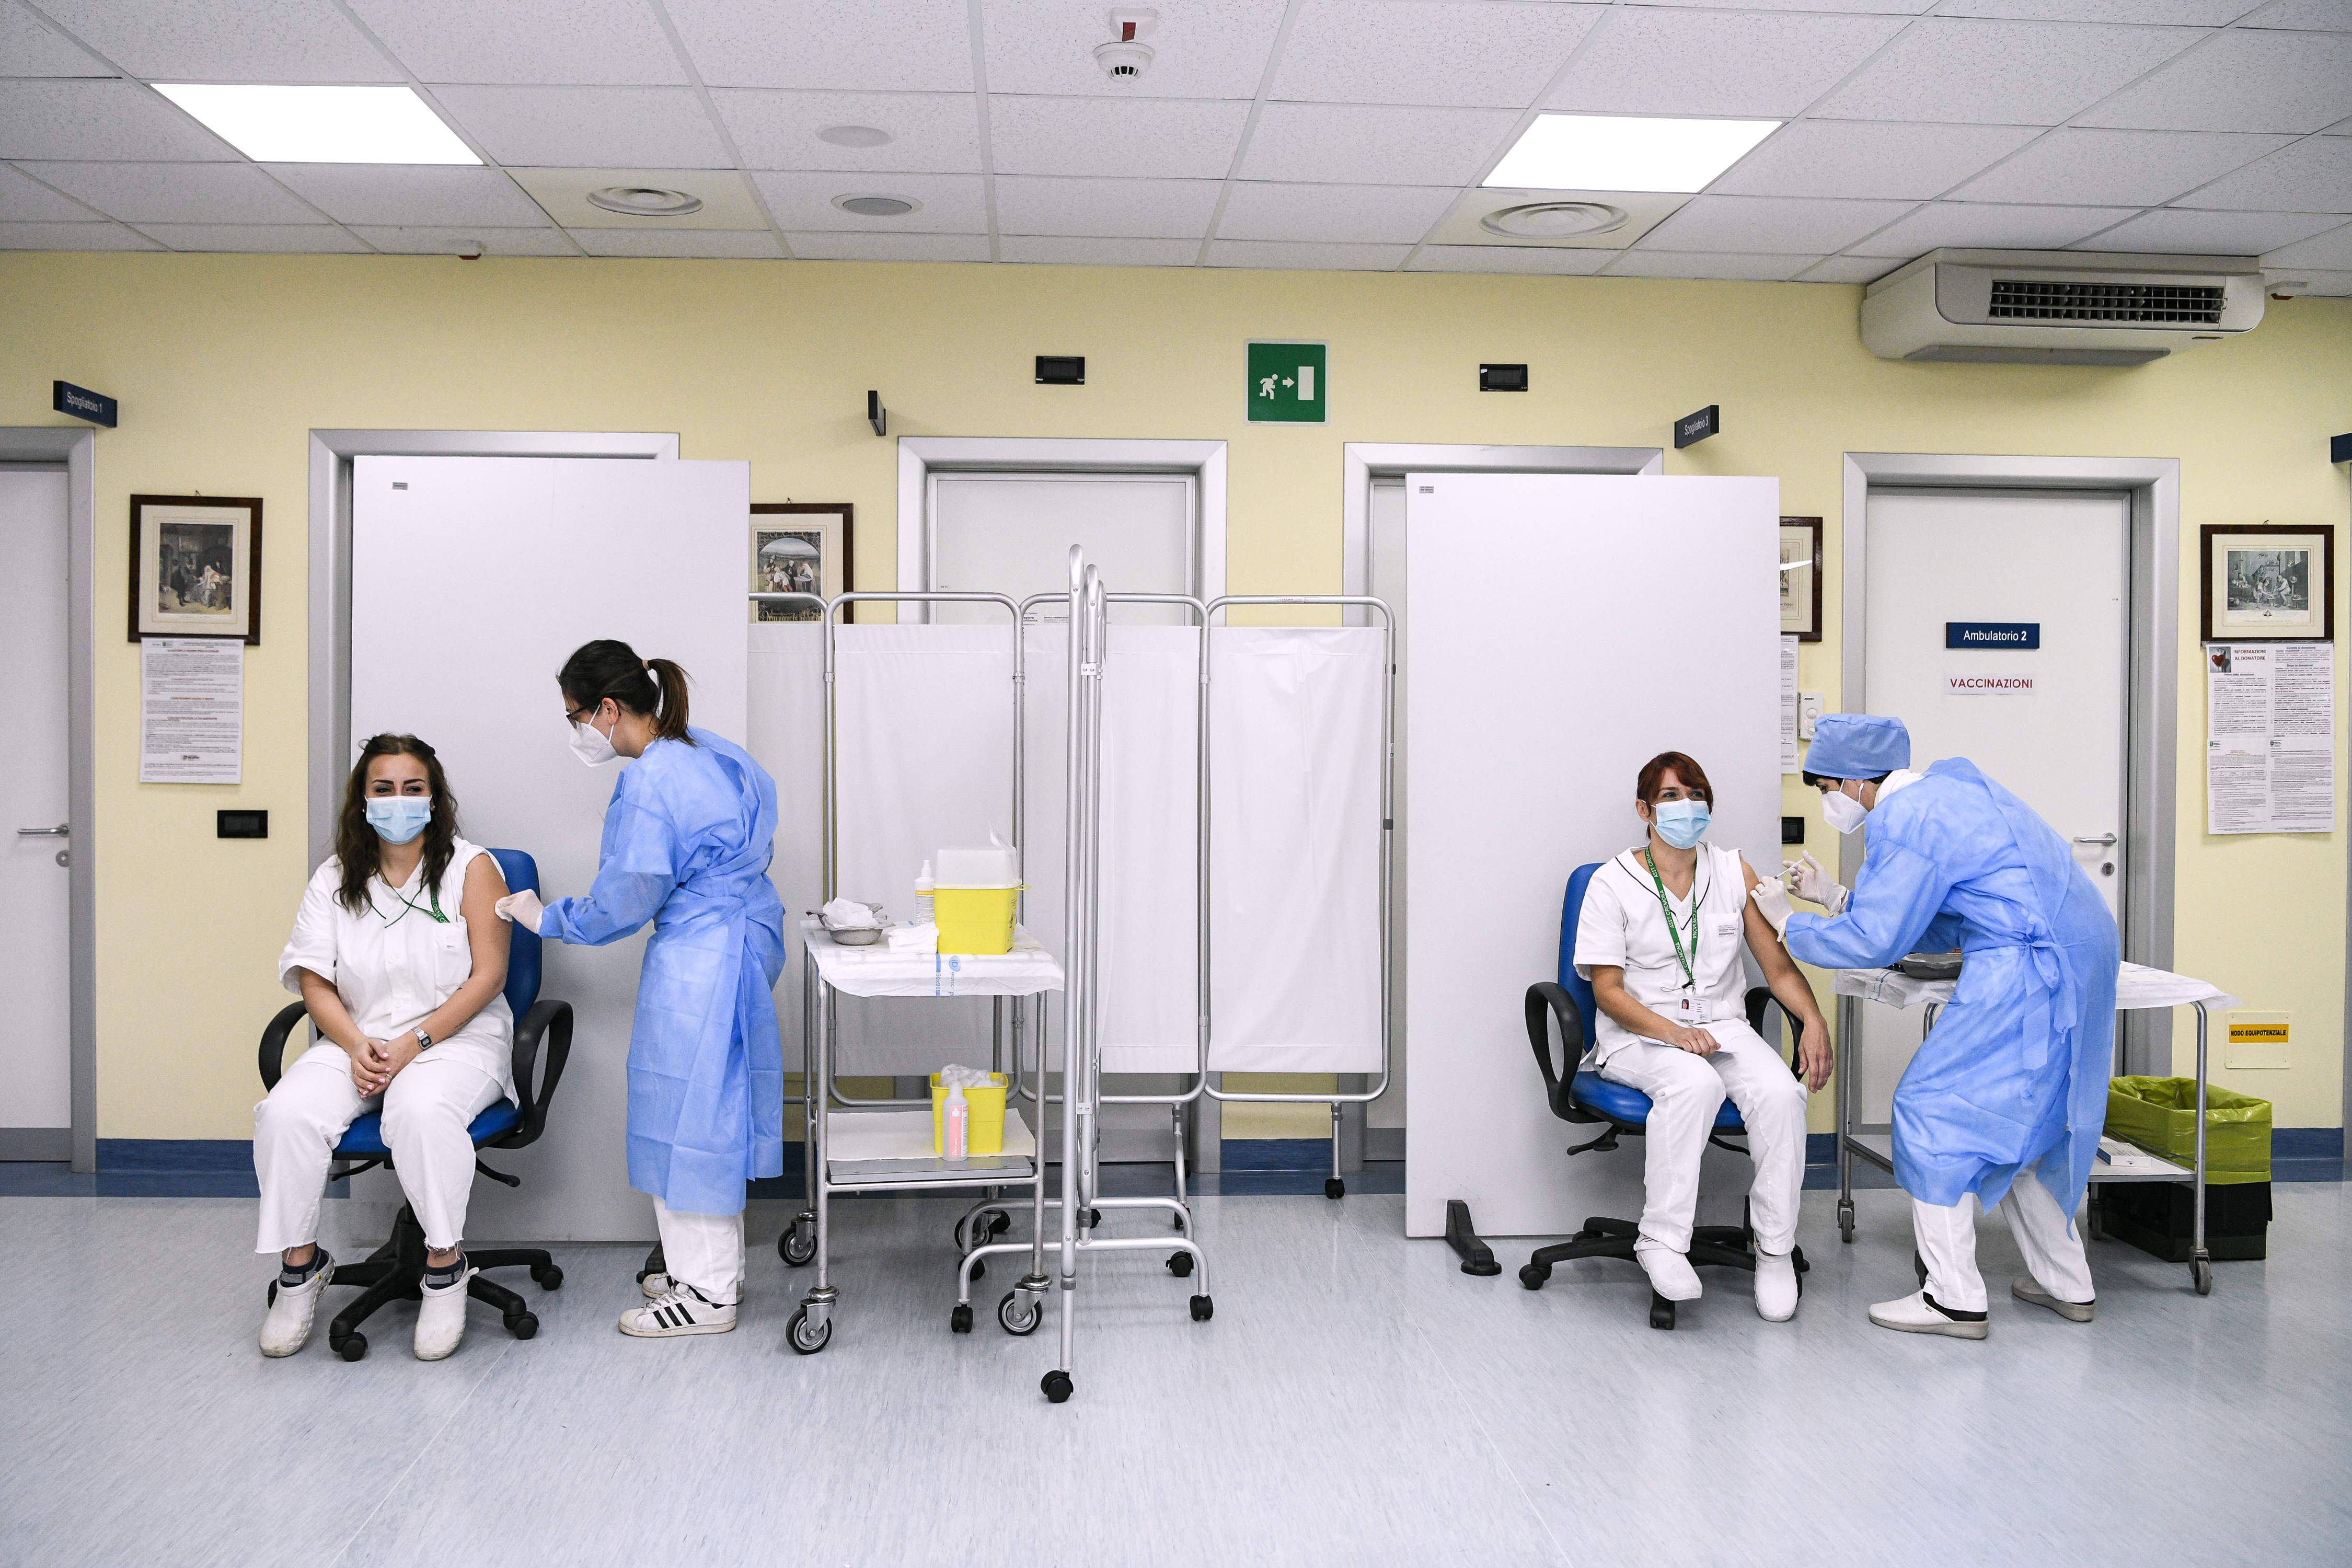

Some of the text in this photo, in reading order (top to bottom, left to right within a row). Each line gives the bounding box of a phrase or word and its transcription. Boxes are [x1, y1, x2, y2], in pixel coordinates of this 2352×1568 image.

[66, 390, 102, 413] Spogliatoio 1
[1684, 415, 1708, 437] Spogliatoio 3
[1963, 630, 2027, 641] Ambulatorio 2
[1950, 678, 2032, 688] VACCINAZIONI
[1651, 867, 1659, 878] ASST
[1659, 890, 1671, 916] CREMONA
[1675, 942, 1687, 968] CREMONA
